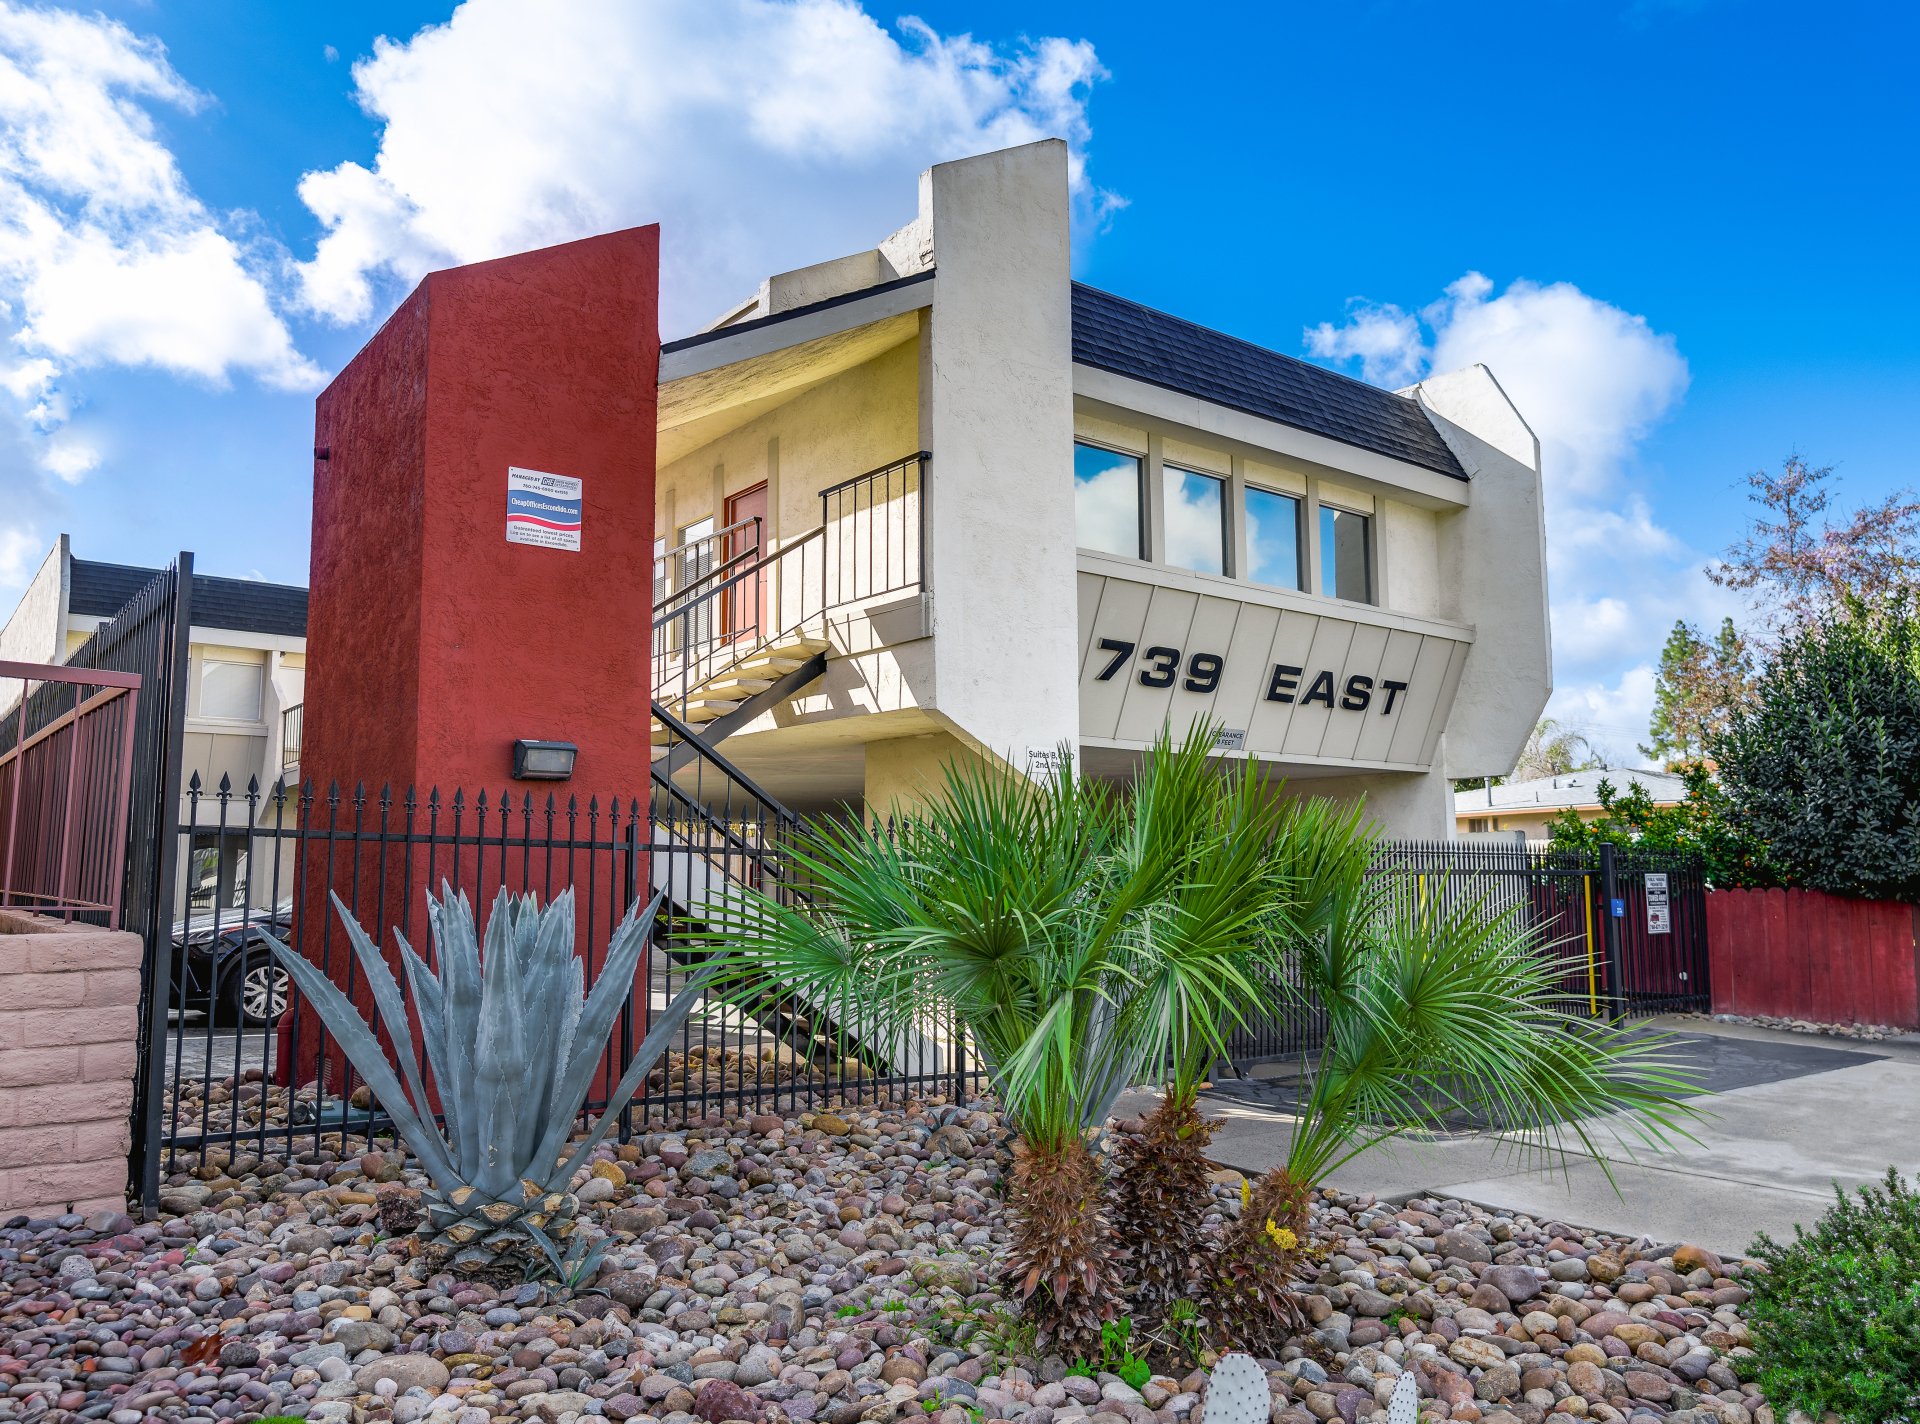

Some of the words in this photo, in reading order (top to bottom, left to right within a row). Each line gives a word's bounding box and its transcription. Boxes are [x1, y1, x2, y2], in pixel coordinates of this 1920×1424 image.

[511, 497, 579, 515] CheapOfficesEscondido.com
[513, 525, 541, 533] Guaranteed
[1095, 637, 1224, 693] 739
[1264, 662, 1408, 715] EAST
[1212, 731, 1243, 739] CEARANCE
[1028, 750, 1050, 759] Suites
[1035, 761, 1049, 769] 2nd
[1051, 762, 1067, 770] Flo
